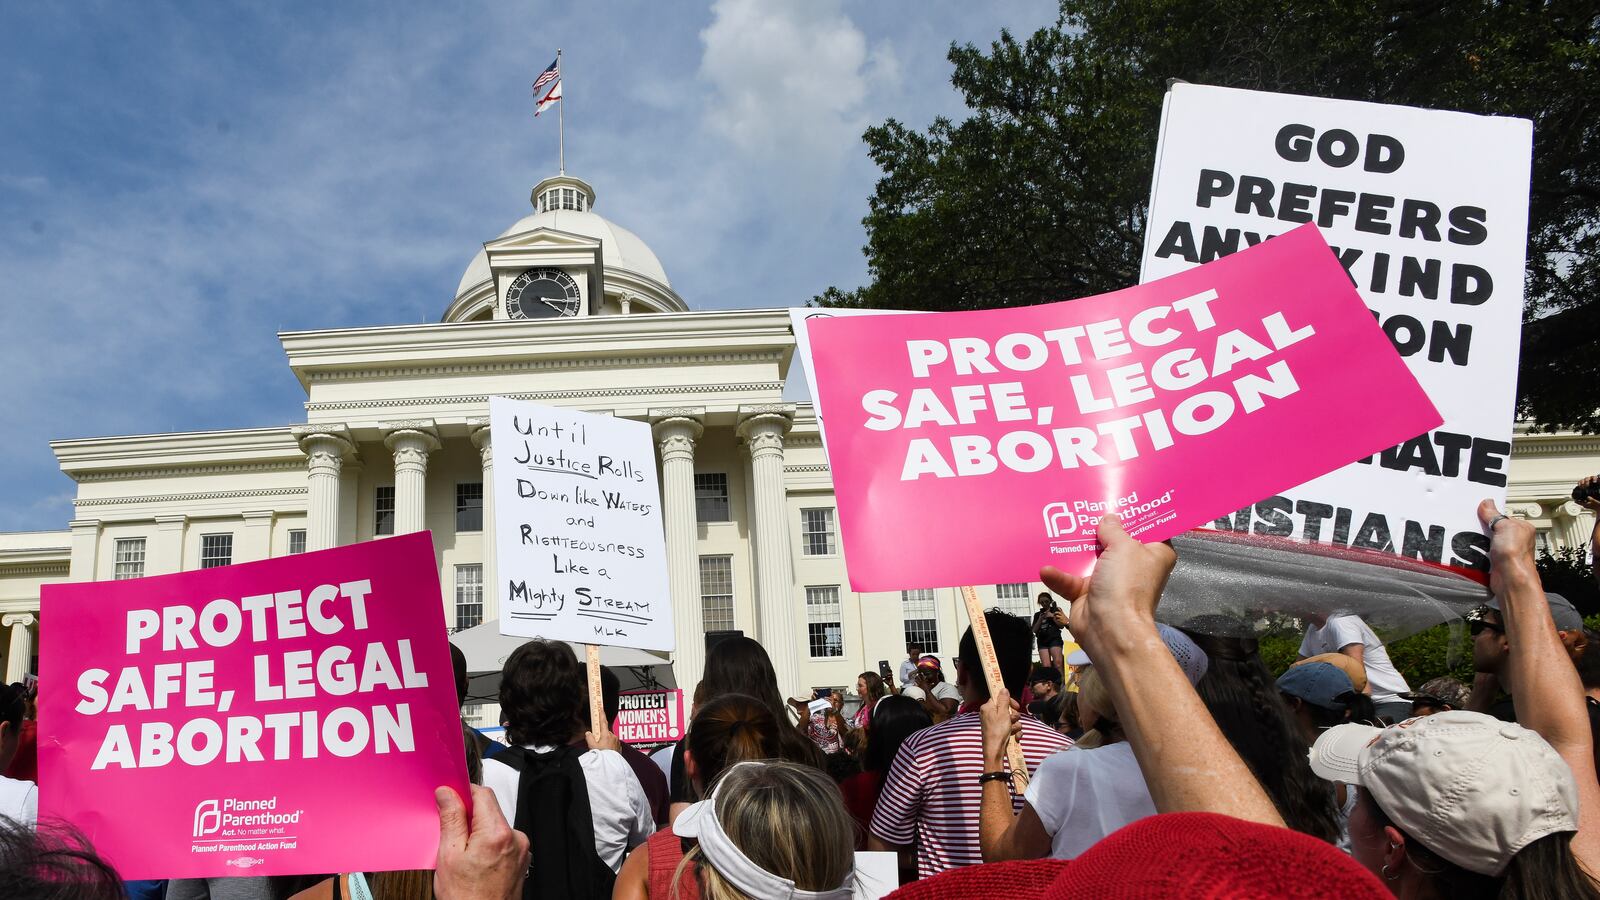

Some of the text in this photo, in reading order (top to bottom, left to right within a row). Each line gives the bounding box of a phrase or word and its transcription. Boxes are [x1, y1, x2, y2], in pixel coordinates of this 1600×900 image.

[1275, 123, 1405, 174] GOD
[1196, 168, 1488, 245] PREFERS
[906, 288, 1219, 378] PROTECT
[862, 311, 1316, 432] SAFE, LEGAL
[513, 415, 586, 445] Until
[900, 359, 1300, 481] ABORTION
[514, 440, 644, 482] Justice Rolls
[516, 478, 569, 503] Down
[575, 485, 599, 506] like
[565, 516, 595, 528] and
[553, 553, 611, 579] Like a
[126, 579, 372, 654] PROTECT
[594, 625, 627, 637] MLK
[75, 639, 429, 716] SAFE, LEGAL
[618, 693, 666, 710] PROTECT
[618, 709, 666, 725] WOMEN'S
[91, 703, 416, 770] ABORTION
[223, 796, 276, 811] Planned
[248, 827, 268, 835] matter
[191, 841, 297, 853] Planned Parenthood Action Fund
